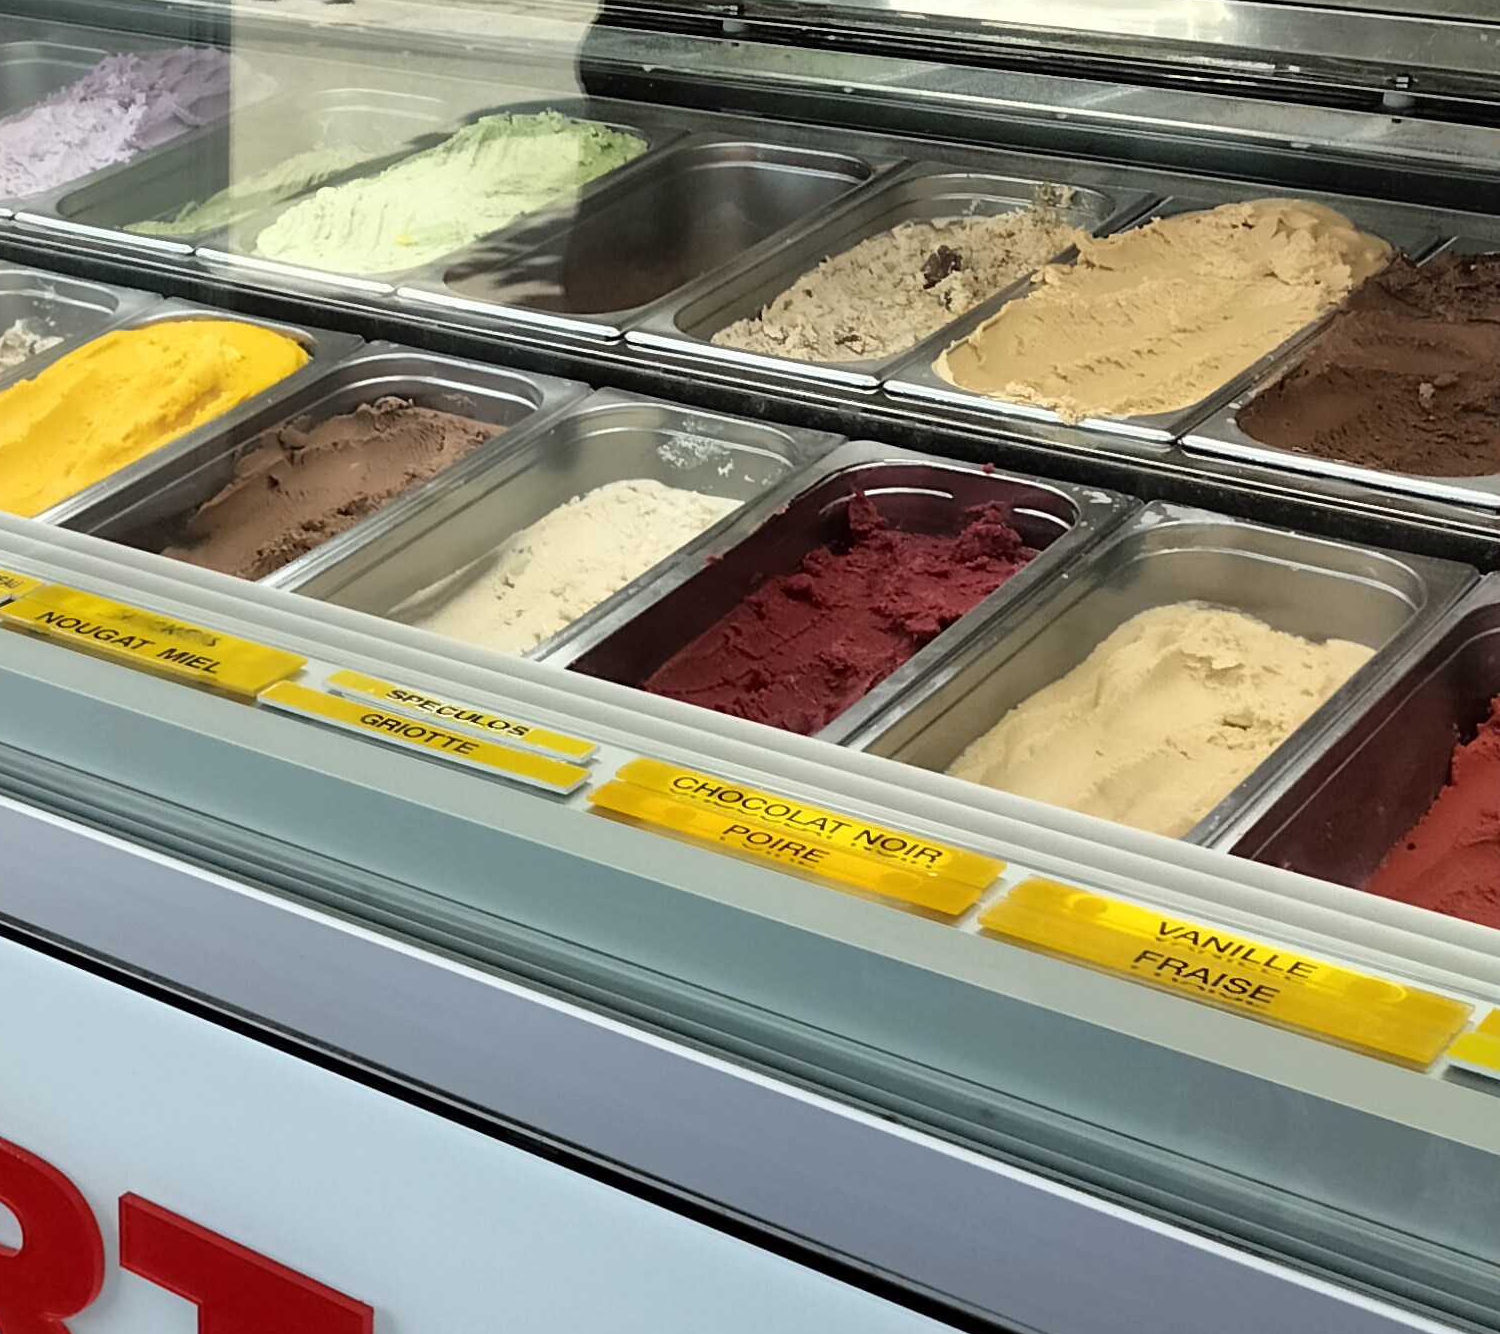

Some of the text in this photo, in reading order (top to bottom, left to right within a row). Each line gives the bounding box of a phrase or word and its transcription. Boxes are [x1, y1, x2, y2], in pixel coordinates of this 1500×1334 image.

[35, 611, 221, 674] NOUGAT MIEL
[359, 713, 480, 756] GRIOTTE
[385, 689, 530, 737] SPECULOS
[672, 776, 944, 867] CHOCOLAT NOIR
[722, 823, 831, 866] POIRE
[1133, 948, 1282, 1007] FRAISE
[1155, 921, 1320, 979] VANILLE
